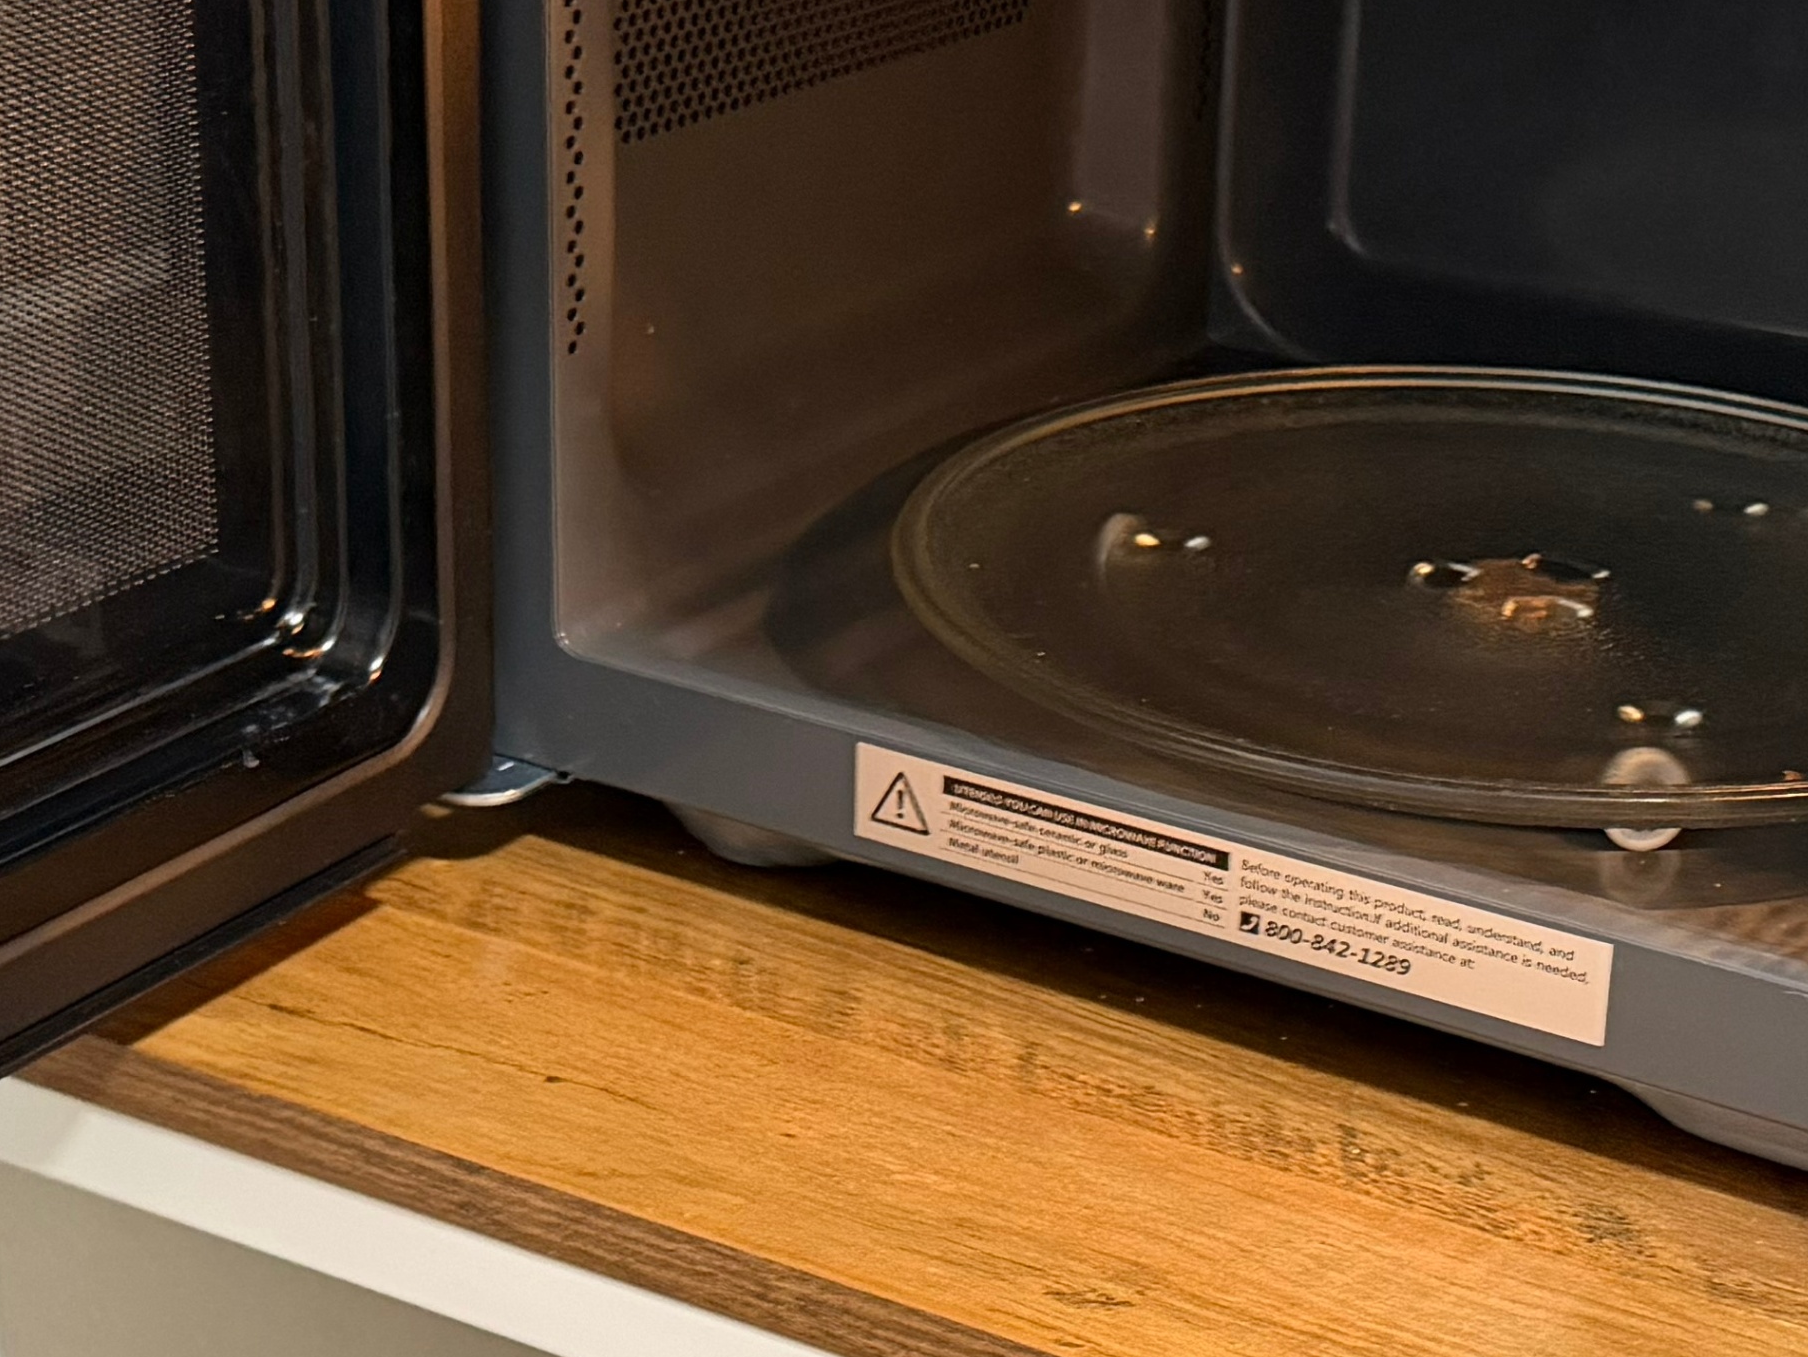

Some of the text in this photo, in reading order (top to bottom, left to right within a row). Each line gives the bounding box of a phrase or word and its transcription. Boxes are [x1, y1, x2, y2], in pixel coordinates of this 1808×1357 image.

[948, 799, 1129, 863] Microwave-safe ceramic or glass
[948, 835, 1019, 866] Metal utensil
[948, 817, 1185, 895] Microwave-safe plastic or microwave ware
[1201, 869, 1223, 885] Yes
[1201, 887, 1223, 903] Yes
[1202, 906, 1221, 923] No
[1238, 892, 1278, 914] please
[1281, 903, 1327, 927] contact
[1329, 916, 1389, 944] customer
[1391, 933, 1456, 963] assistance
[1239, 874, 1278, 897] follow
[1280, 885, 1301, 903] the
[1384, 914, 1449, 944] additional
[1451, 933, 1519, 963] assistance
[1520, 952, 1533, 967] is
[1240, 857, 1281, 881] Before
[1283, 869, 1344, 901] operating
[1348, 887, 1372, 906] this
[1548, 942, 1575, 962] and
[1264, 920, 1412, 976] 800-842-1289
